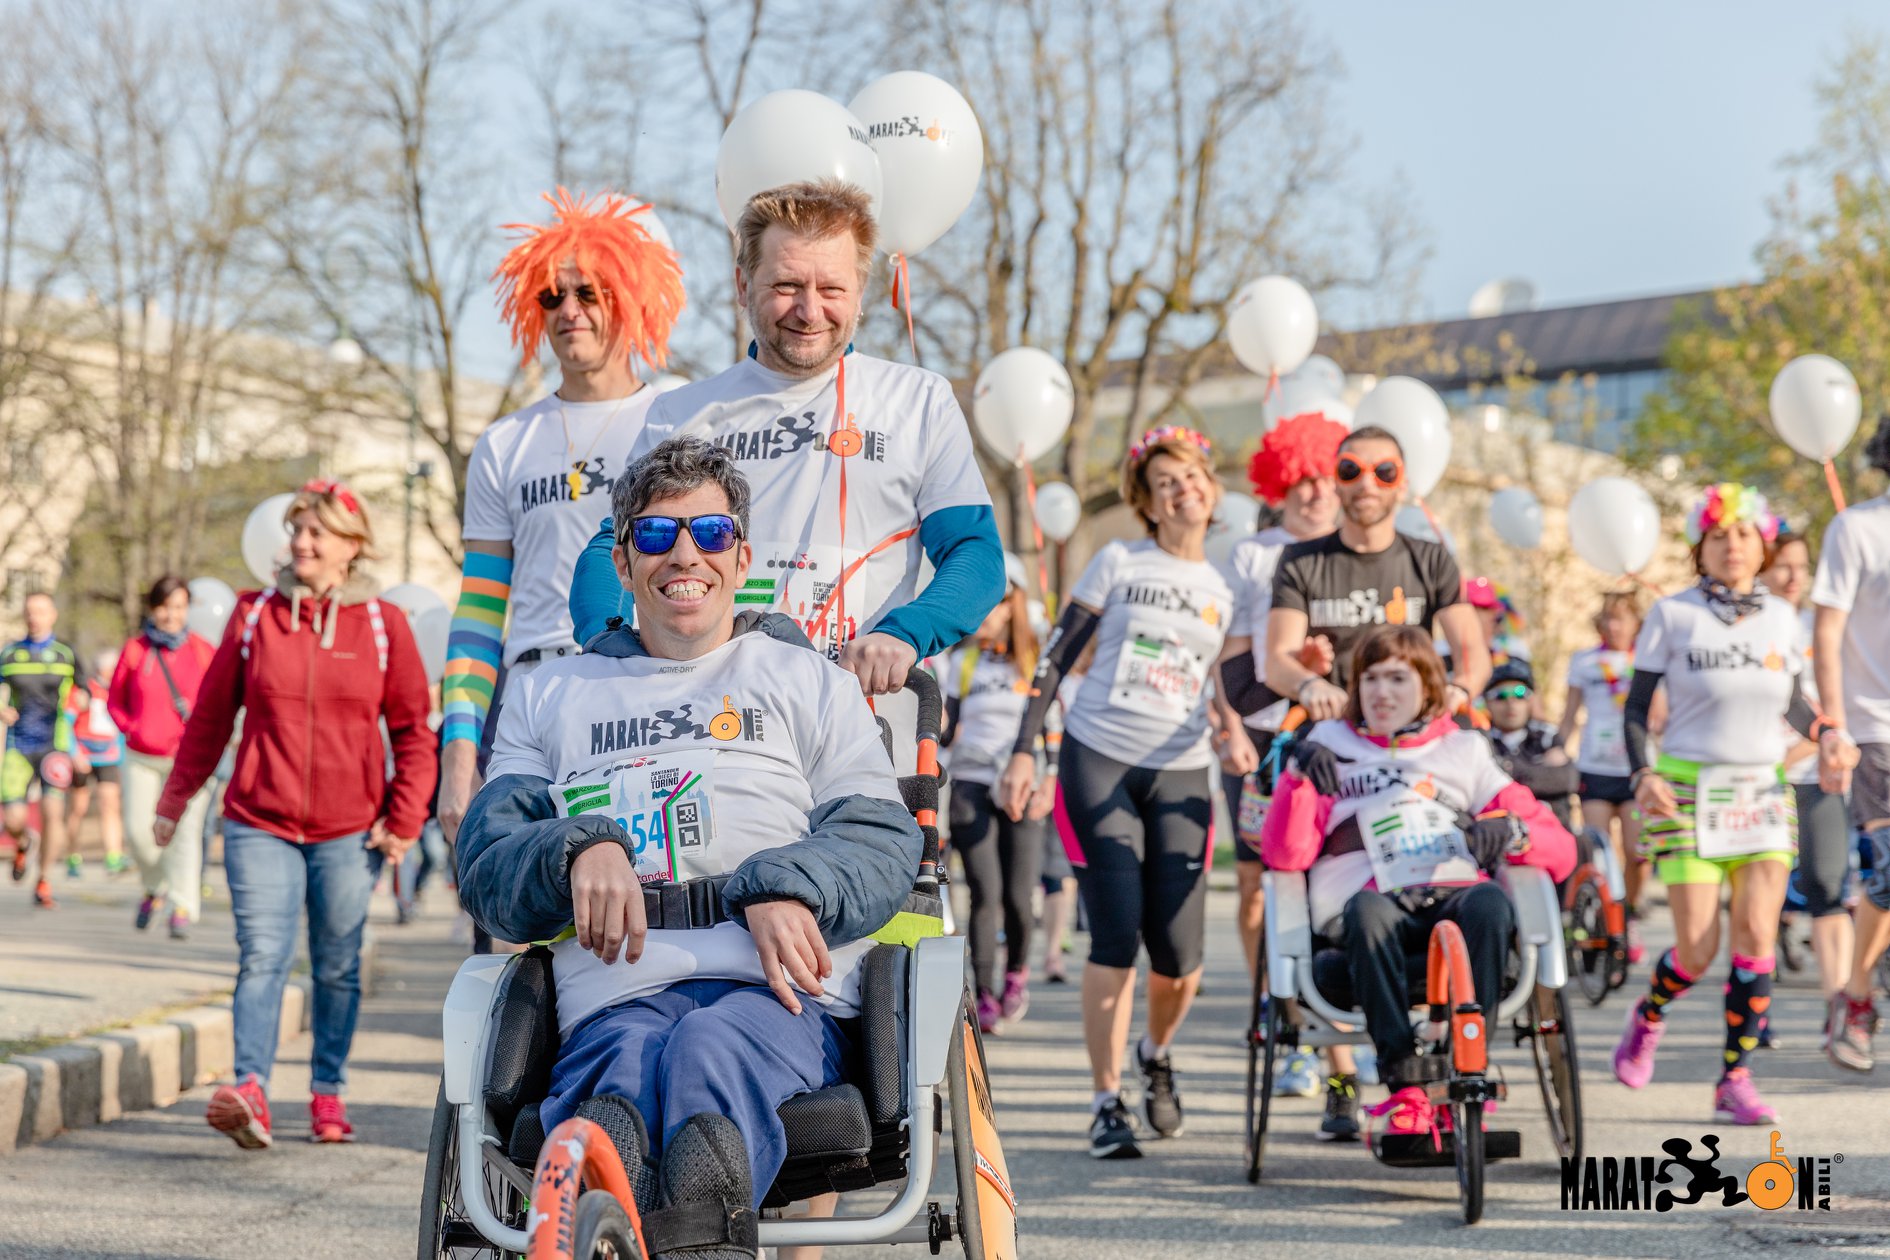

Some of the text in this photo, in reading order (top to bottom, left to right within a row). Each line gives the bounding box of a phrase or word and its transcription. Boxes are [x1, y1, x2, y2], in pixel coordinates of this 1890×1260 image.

[754, 708, 765, 742] ABILI
[651, 777, 679, 789] TORINO
[577, 799, 602, 811] GRIGLIA
